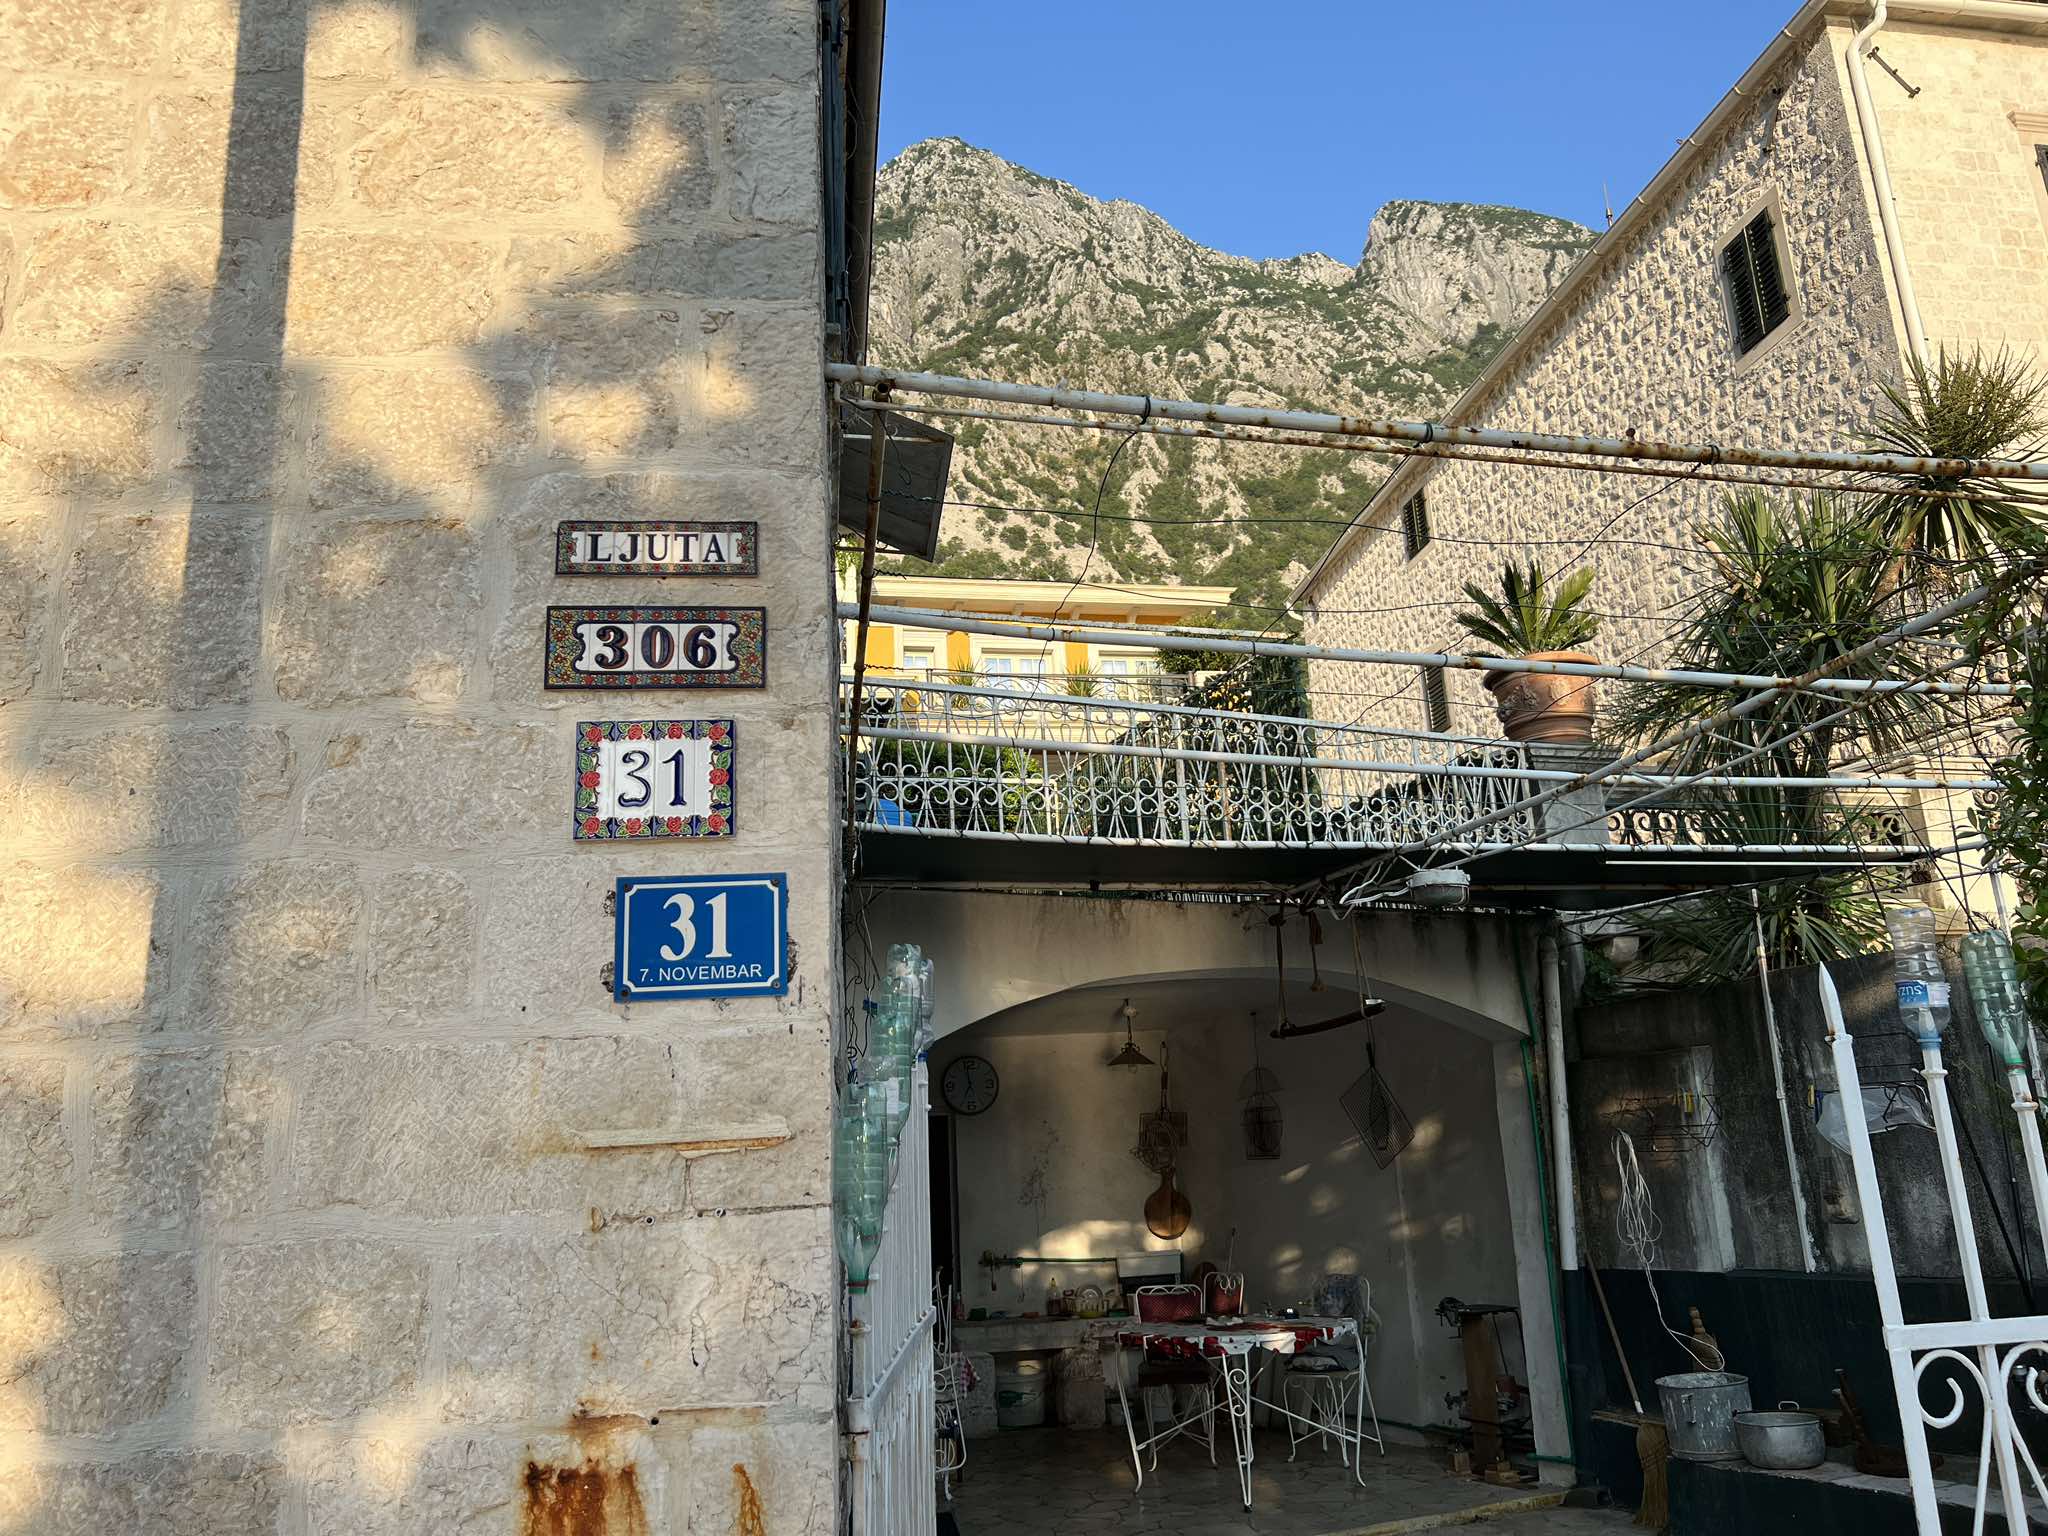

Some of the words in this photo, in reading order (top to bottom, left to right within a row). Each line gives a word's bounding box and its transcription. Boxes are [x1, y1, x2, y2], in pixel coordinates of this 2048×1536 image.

[587, 533, 726, 563] LJUTA
[594, 624, 718, 670] 306
[617, 749, 688, 808] 31
[659, 891, 733, 961] 31
[639, 968, 654, 982] 7.
[659, 963, 763, 981] NOVEMBAR
